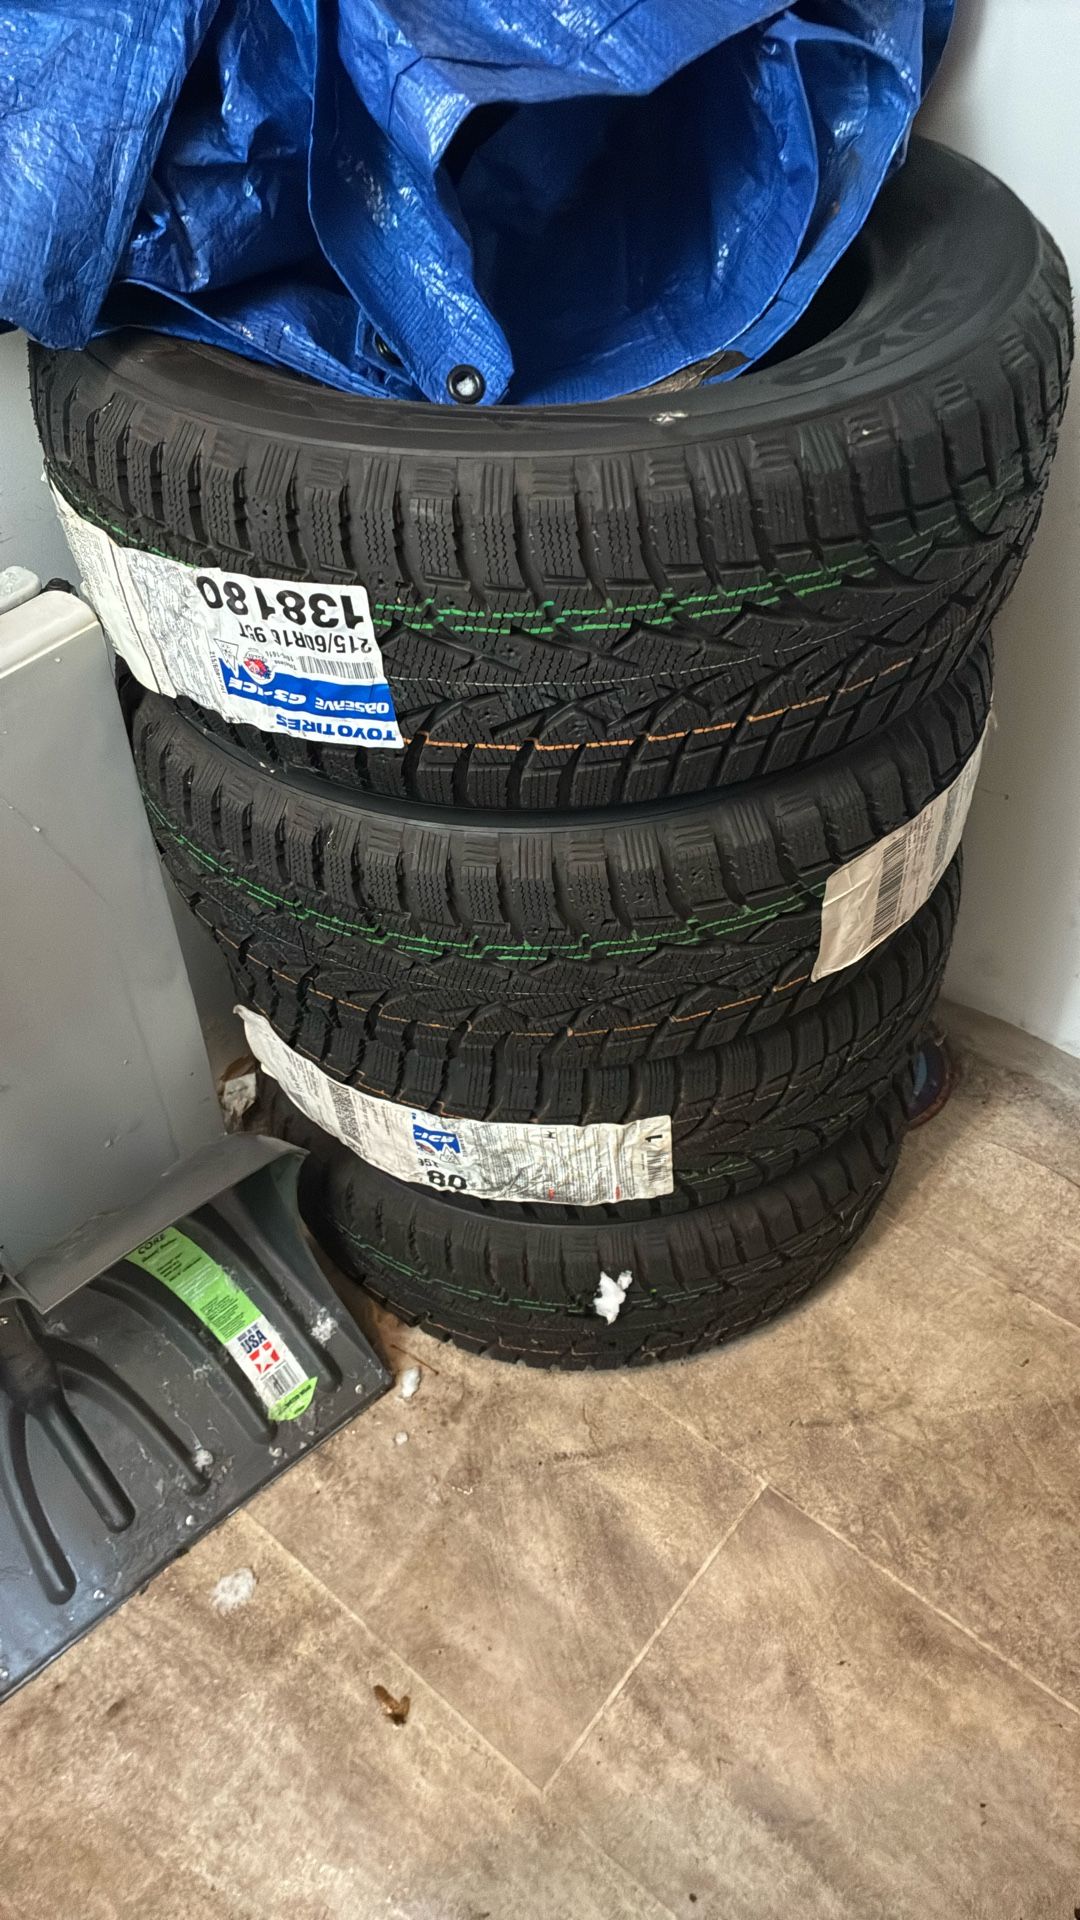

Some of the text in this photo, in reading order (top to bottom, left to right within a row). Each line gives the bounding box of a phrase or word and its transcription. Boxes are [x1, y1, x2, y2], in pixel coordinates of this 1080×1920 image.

[196, 575, 365, 630] 138180
[228, 676, 307, 705] G3-ICE
[315, 697, 390, 715] OBSERVE
[275, 713, 397, 742] TOYO TIRES
[240, 1329, 267, 1354] USA
